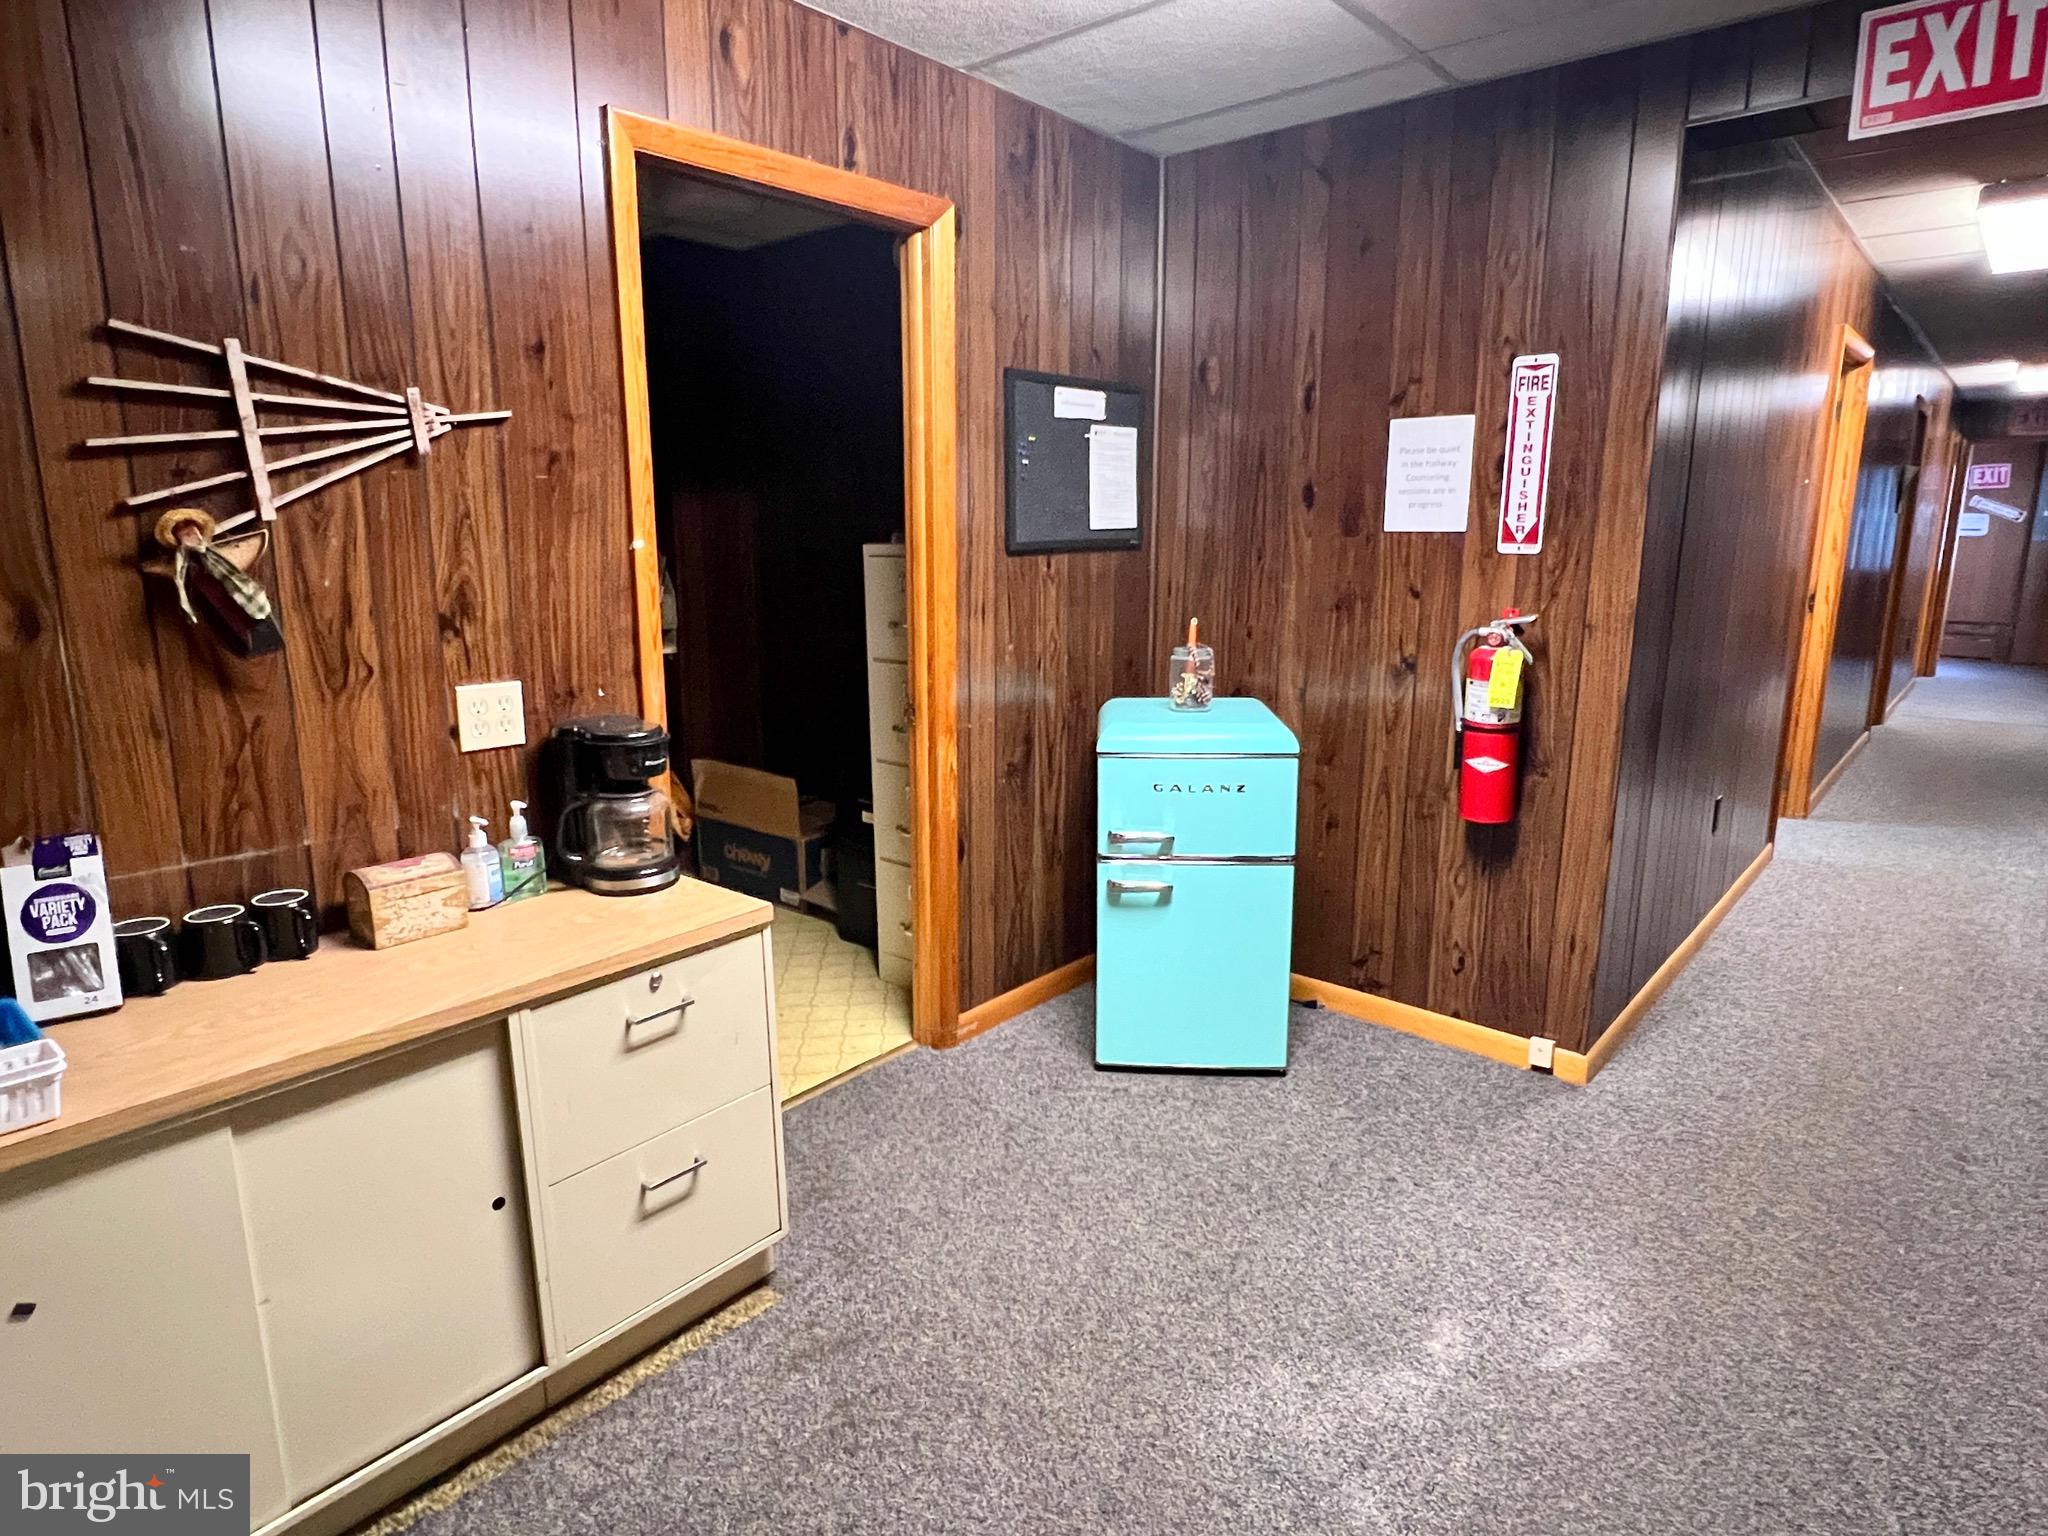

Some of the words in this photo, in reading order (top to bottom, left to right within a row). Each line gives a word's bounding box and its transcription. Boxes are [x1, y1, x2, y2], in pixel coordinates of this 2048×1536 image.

[1868, 0, 2047, 109] EXIT
[1518, 374, 1550, 392] FIRE
[1515, 395, 1538, 534] EXTINGUISHER
[1973, 466, 2008, 484] EXIT
[1153, 783, 1247, 793] GALANZ
[29, 896, 85, 919] VARIETY
[42, 911, 78, 931] PACK
[84, 996, 99, 1006] 24
